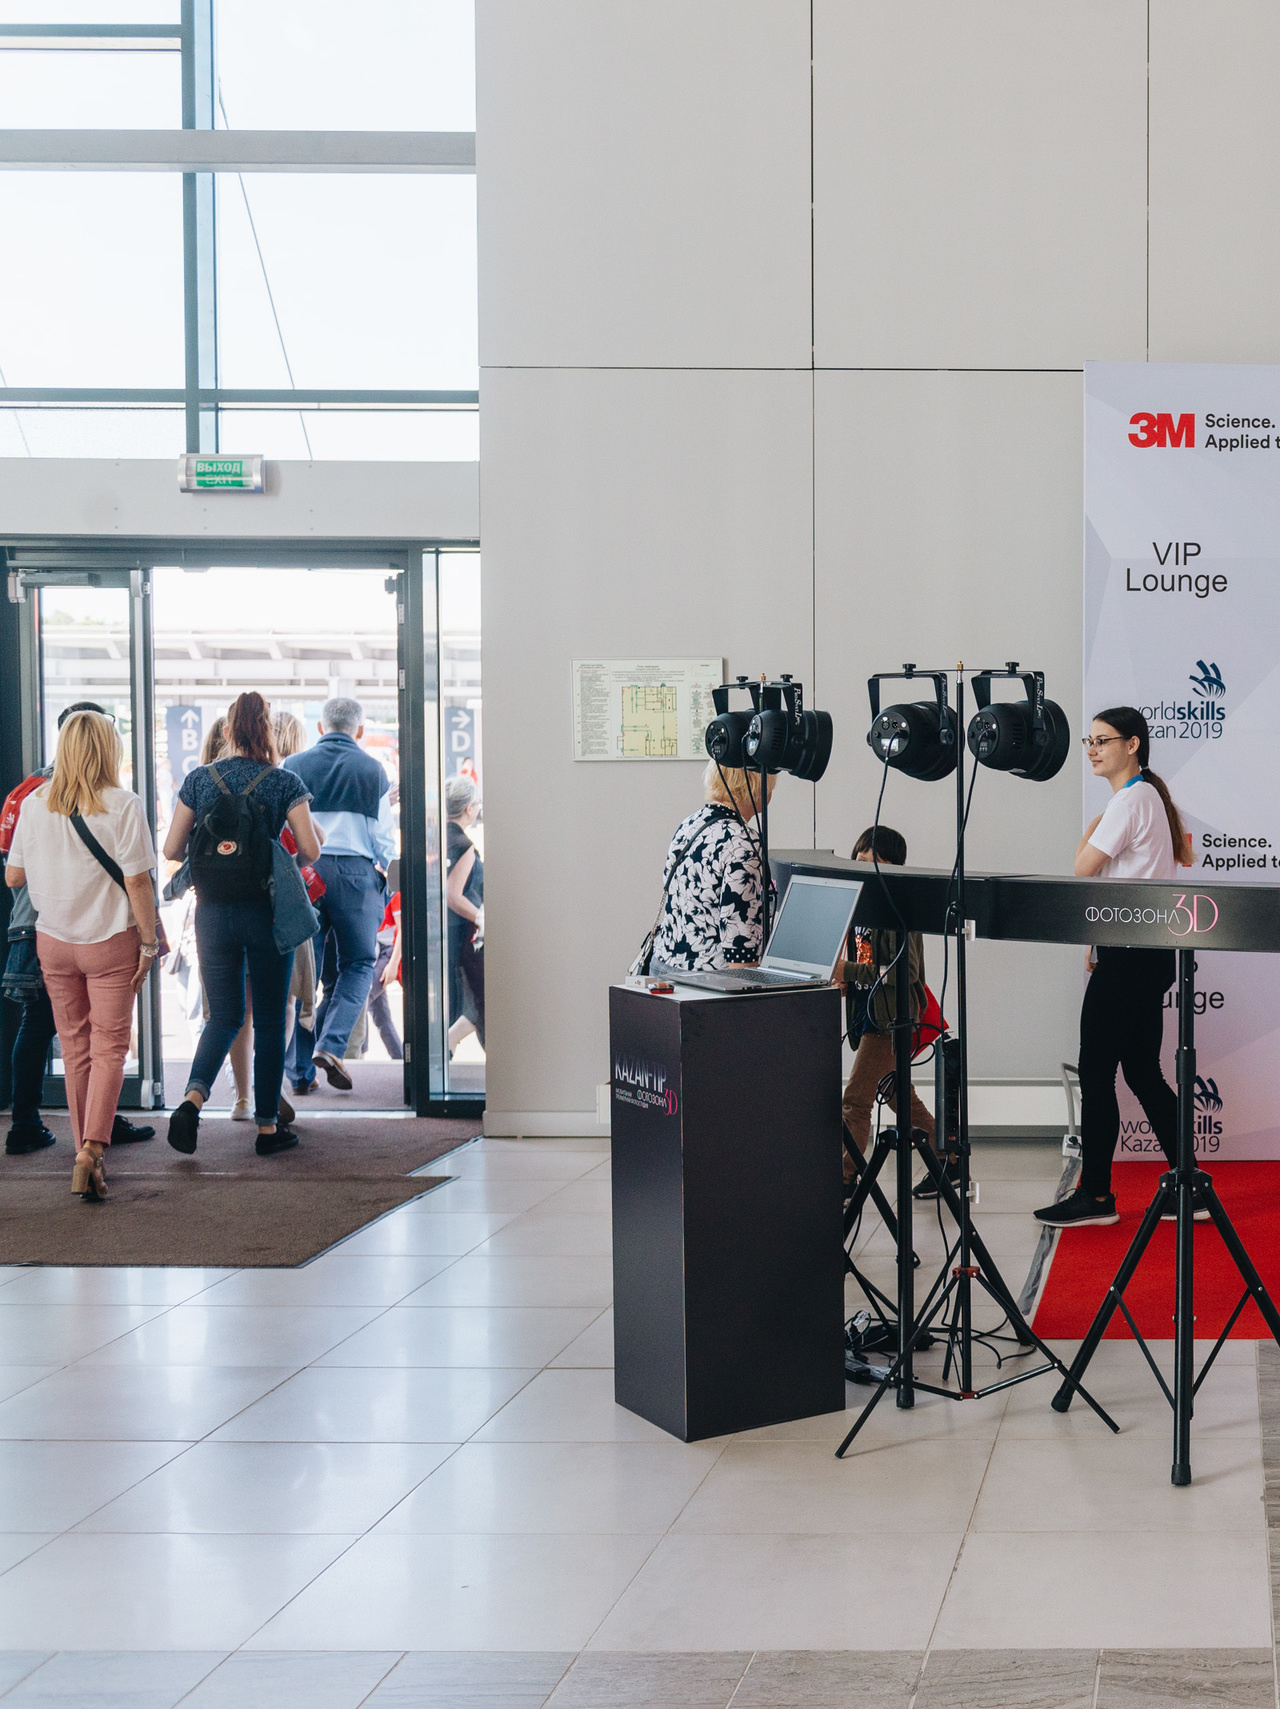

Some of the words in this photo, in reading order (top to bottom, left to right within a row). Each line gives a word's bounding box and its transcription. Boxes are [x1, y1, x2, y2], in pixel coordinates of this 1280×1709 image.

[1128, 412, 1195, 448] 3M
[1205, 414, 1276, 428] Science.
[1205, 434, 1270, 451] Applied
[197, 462, 241, 474] ВЫХОД
[1152, 542, 1202, 566] VIP
[1126, 569, 1228, 598] Lounge
[1138, 700, 1226, 721] orldskills
[182, 729, 198, 751] B
[1149, 725, 1176, 738] zan
[1179, 721, 1223, 739] 2019
[452, 730, 471, 752] D
[1202, 833, 1272, 848] Science.
[1202, 854, 1267, 871] Applied
[1167, 893, 1219, 937] 3D
[615, 1053, 667, 1093] KAZAN-TIP
[1121, 1135, 1164, 1152] Kaza
